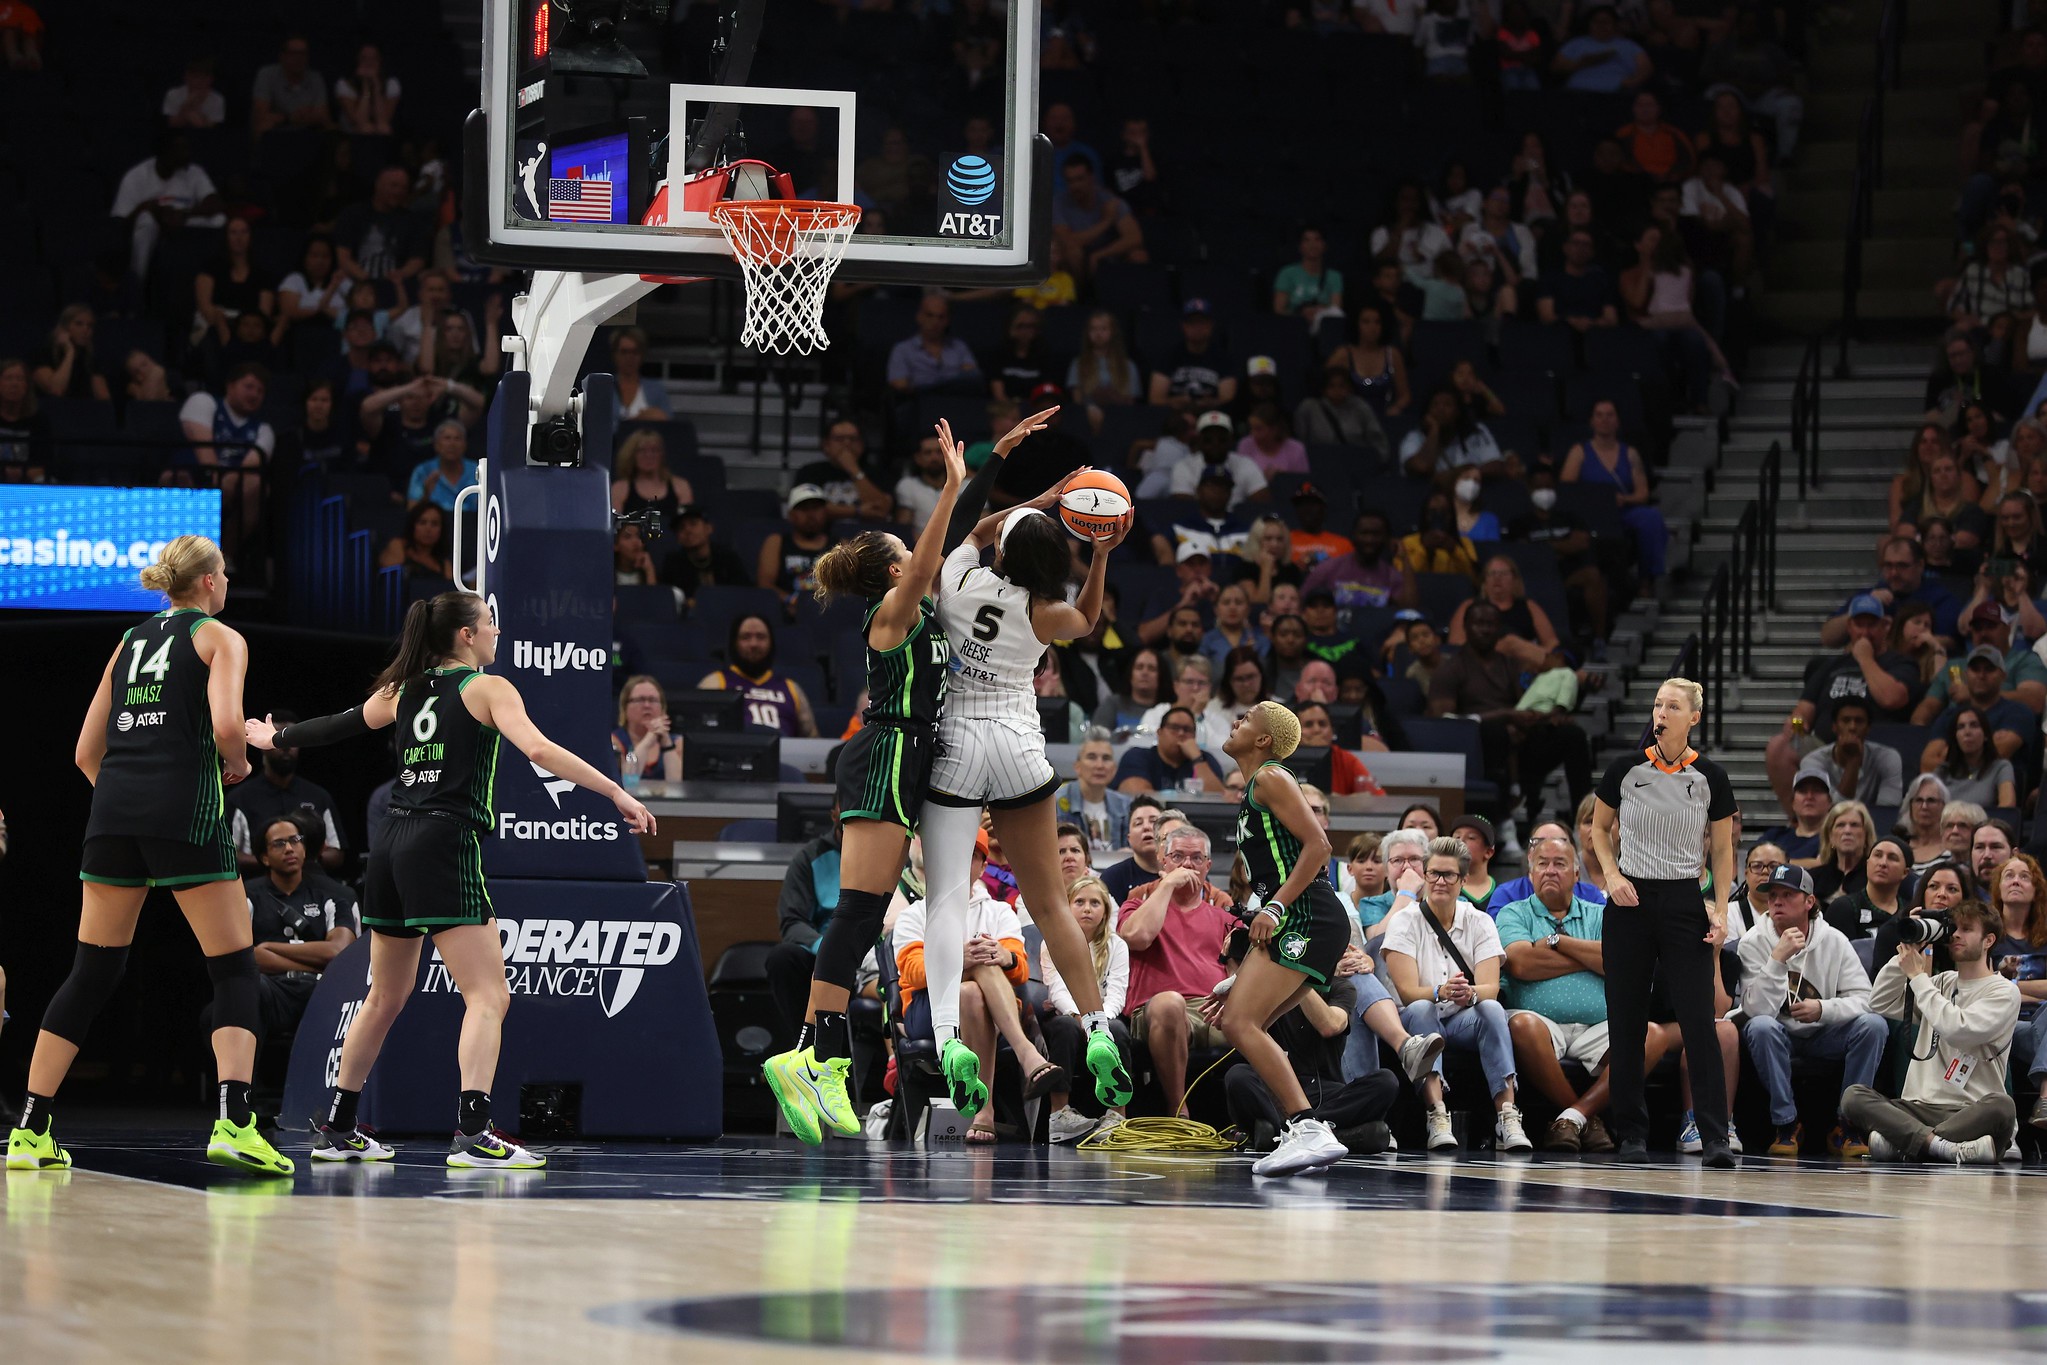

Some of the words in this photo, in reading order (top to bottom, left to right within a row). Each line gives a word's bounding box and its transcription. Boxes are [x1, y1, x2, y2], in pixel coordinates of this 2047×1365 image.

[939, 212, 1001, 236] AT&T
[1071, 516, 1117, 533] Wilson
[972, 604, 1006, 643] 5
[127, 635, 175, 684] 14
[960, 639, 992, 664] REESE
[961, 666, 997, 682] AT&T
[124, 682, 162, 706] JUHÁSZ
[135, 711, 167, 728] AT&T
[412, 695, 440, 743] 6
[747, 703, 781, 730] 10
[417, 769, 442, 783] AT&T
[499, 812, 619, 841] Fanatics
[431, 918, 682, 966] DERATED
[421, 964, 599, 997] INRANCE
